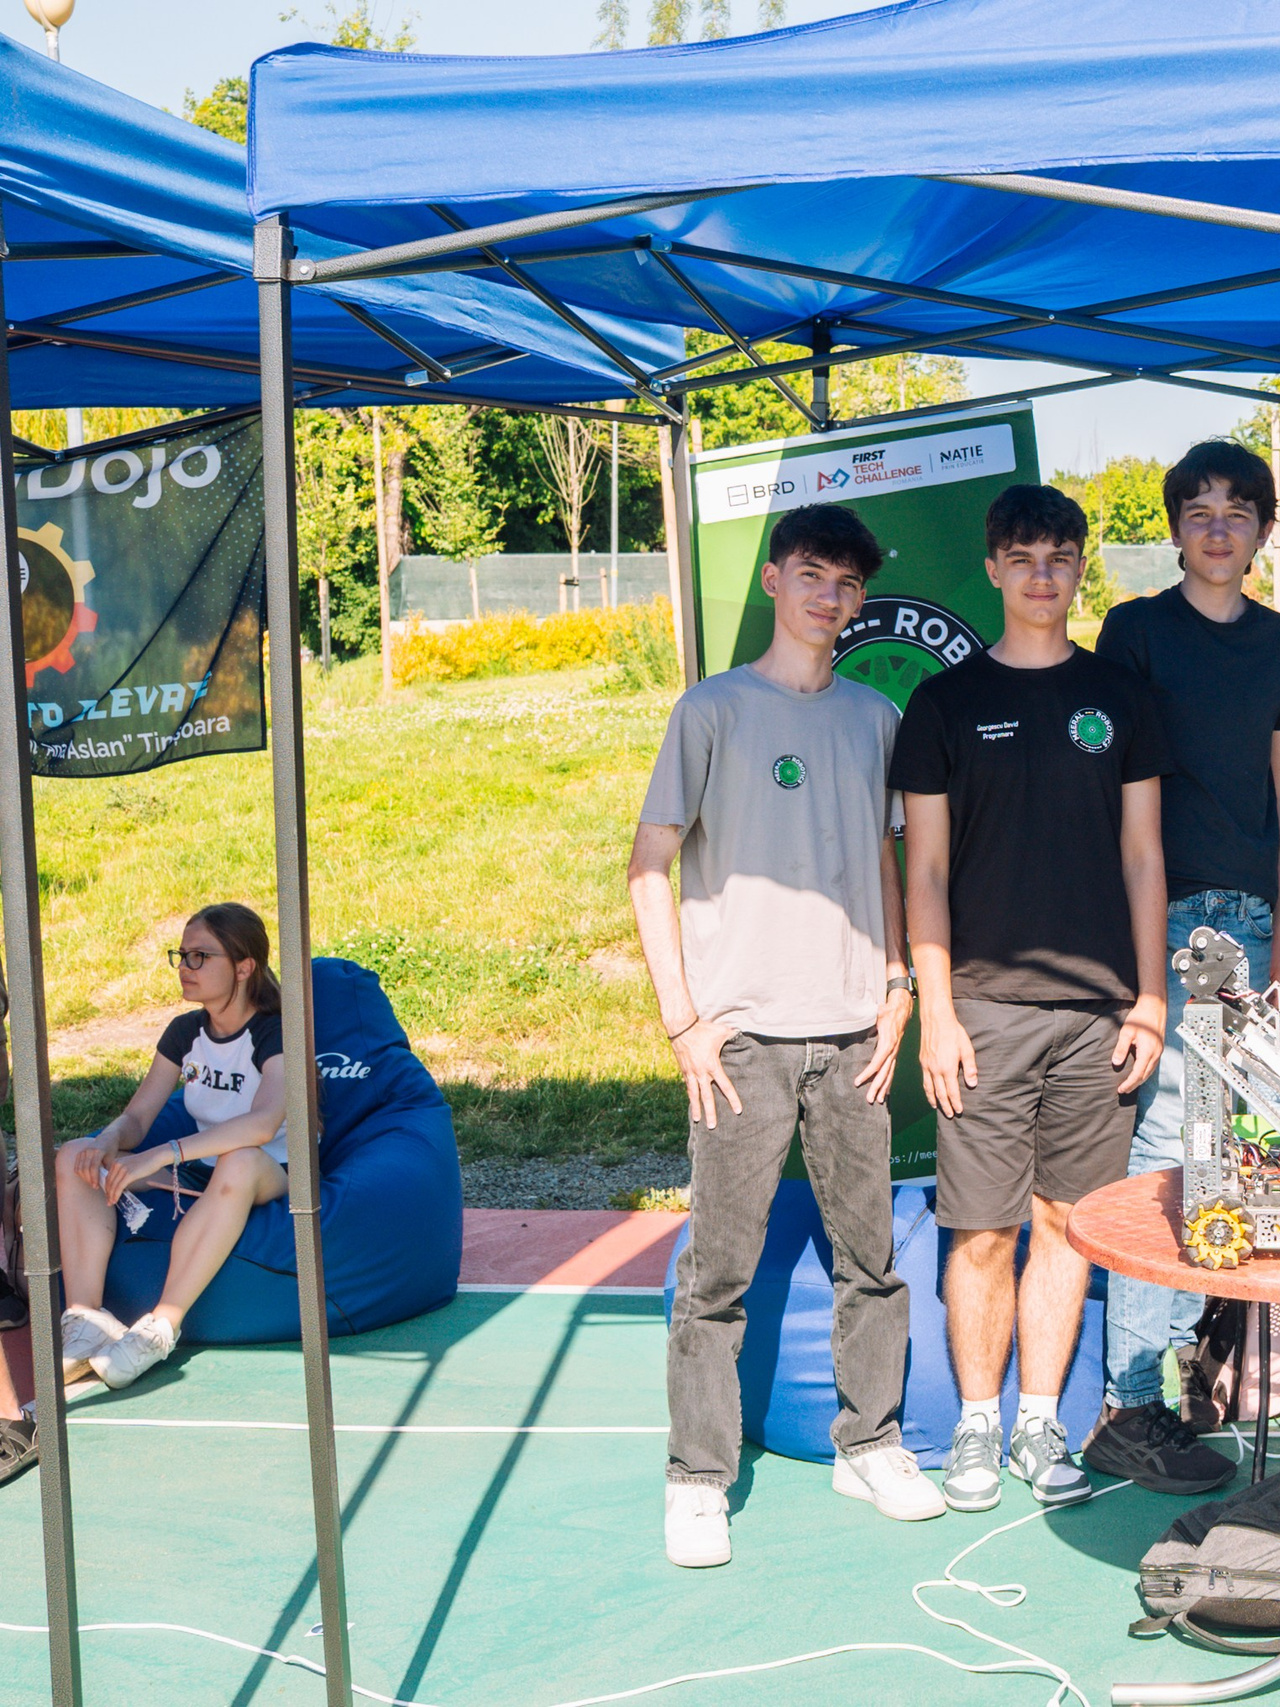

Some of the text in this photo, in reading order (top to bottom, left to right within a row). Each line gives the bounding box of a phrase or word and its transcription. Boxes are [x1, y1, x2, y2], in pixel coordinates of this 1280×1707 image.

[852, 450, 885, 464] FIRST
[15, 440, 222, 509] Dojo
[853, 462, 884, 475] TECH
[854, 465, 923, 485] CHALLENGE
[753, 481, 795, 498] BRD
[1096, 711, 1113, 748] ROBOTICS
[316, 1056, 371, 1080] inde
